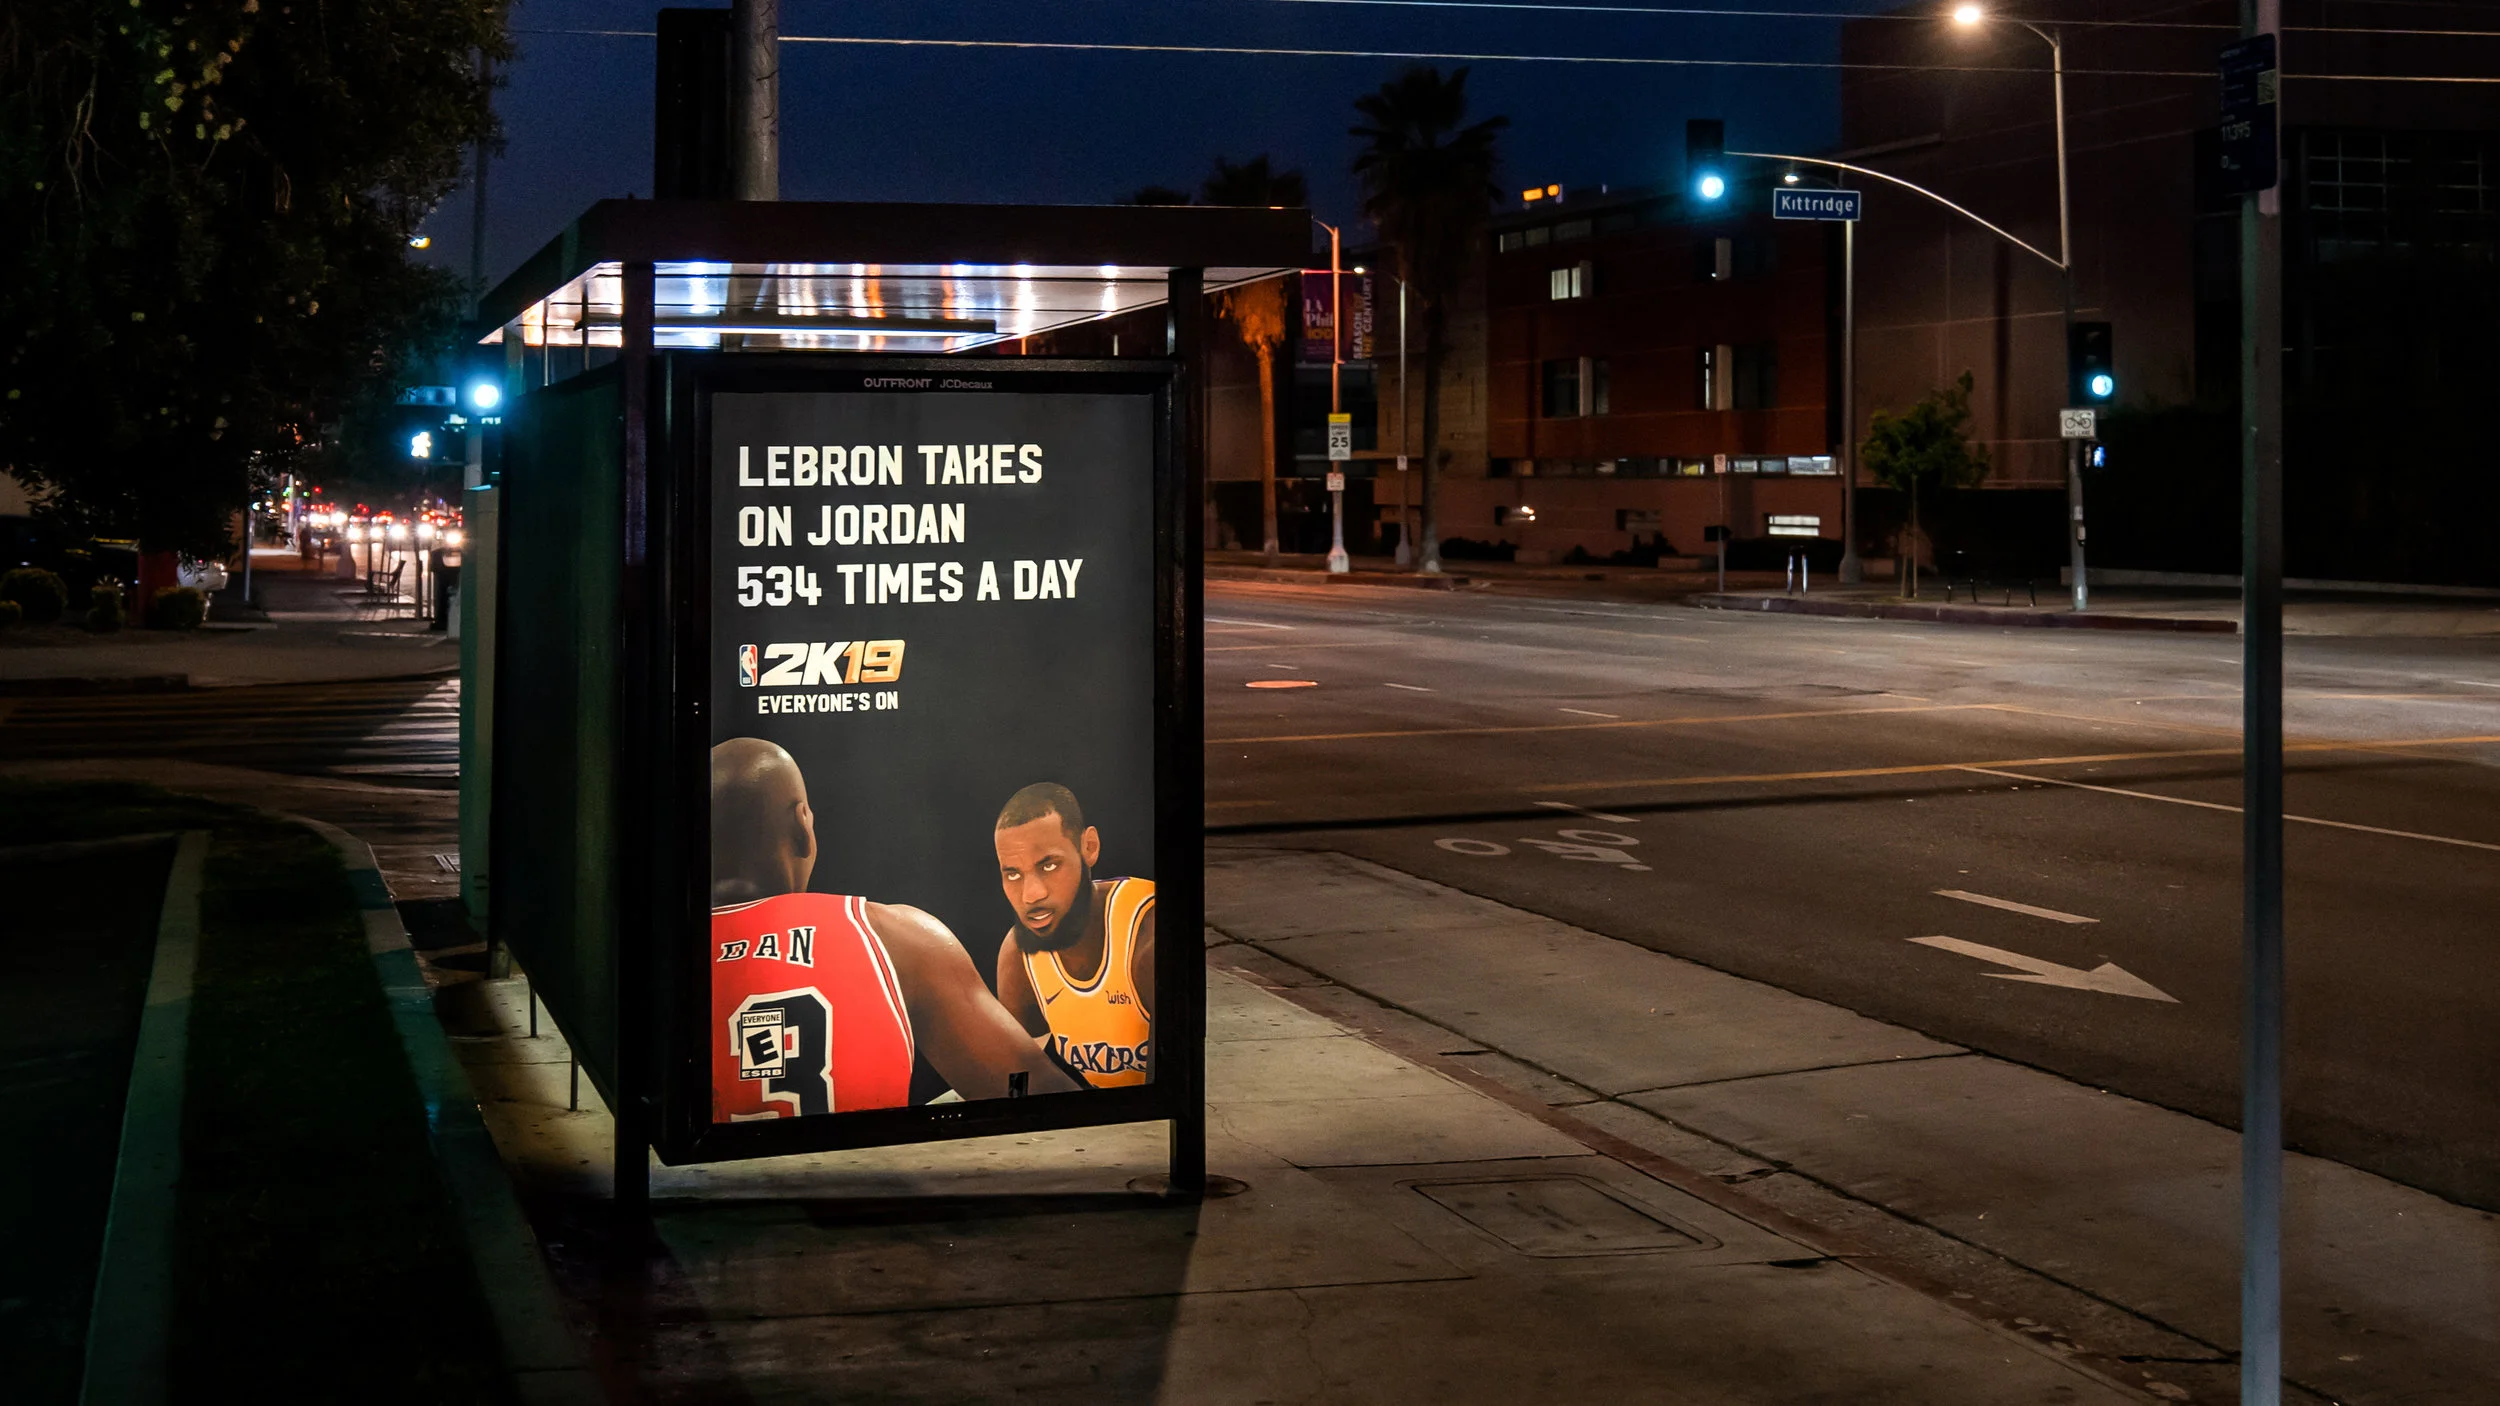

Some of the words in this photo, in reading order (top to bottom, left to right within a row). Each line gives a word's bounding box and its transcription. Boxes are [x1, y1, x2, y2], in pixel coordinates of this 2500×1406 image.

[1781, 195, 1854, 216] Kittridge
[863, 377, 933, 389] OUTFRONT
[939, 378, 993, 389] JCDecaux
[1331, 437, 1349, 448] 25
[739, 445, 902, 487] LEBRON
[918, 444, 1043, 485] TAKES
[738, 506, 792, 547] ON
[807, 503, 965, 546] JORDAN
[737, 565, 822, 607] 534
[837, 562, 964, 605] TIMES
[976, 561, 1001, 602] A
[1014, 558, 1084, 600] DAY
[759, 639, 906, 686] 2K19
[758, 692, 870, 714] EVERYONE'S
[875, 691, 898, 710] ON
[717, 926, 816, 968] DAN
[1106, 989, 1131, 1005] wish
[743, 1013, 782, 1025] EVERYONE
[746, 1029, 779, 1066] E
[742, 1069, 782, 1078] ESRB
